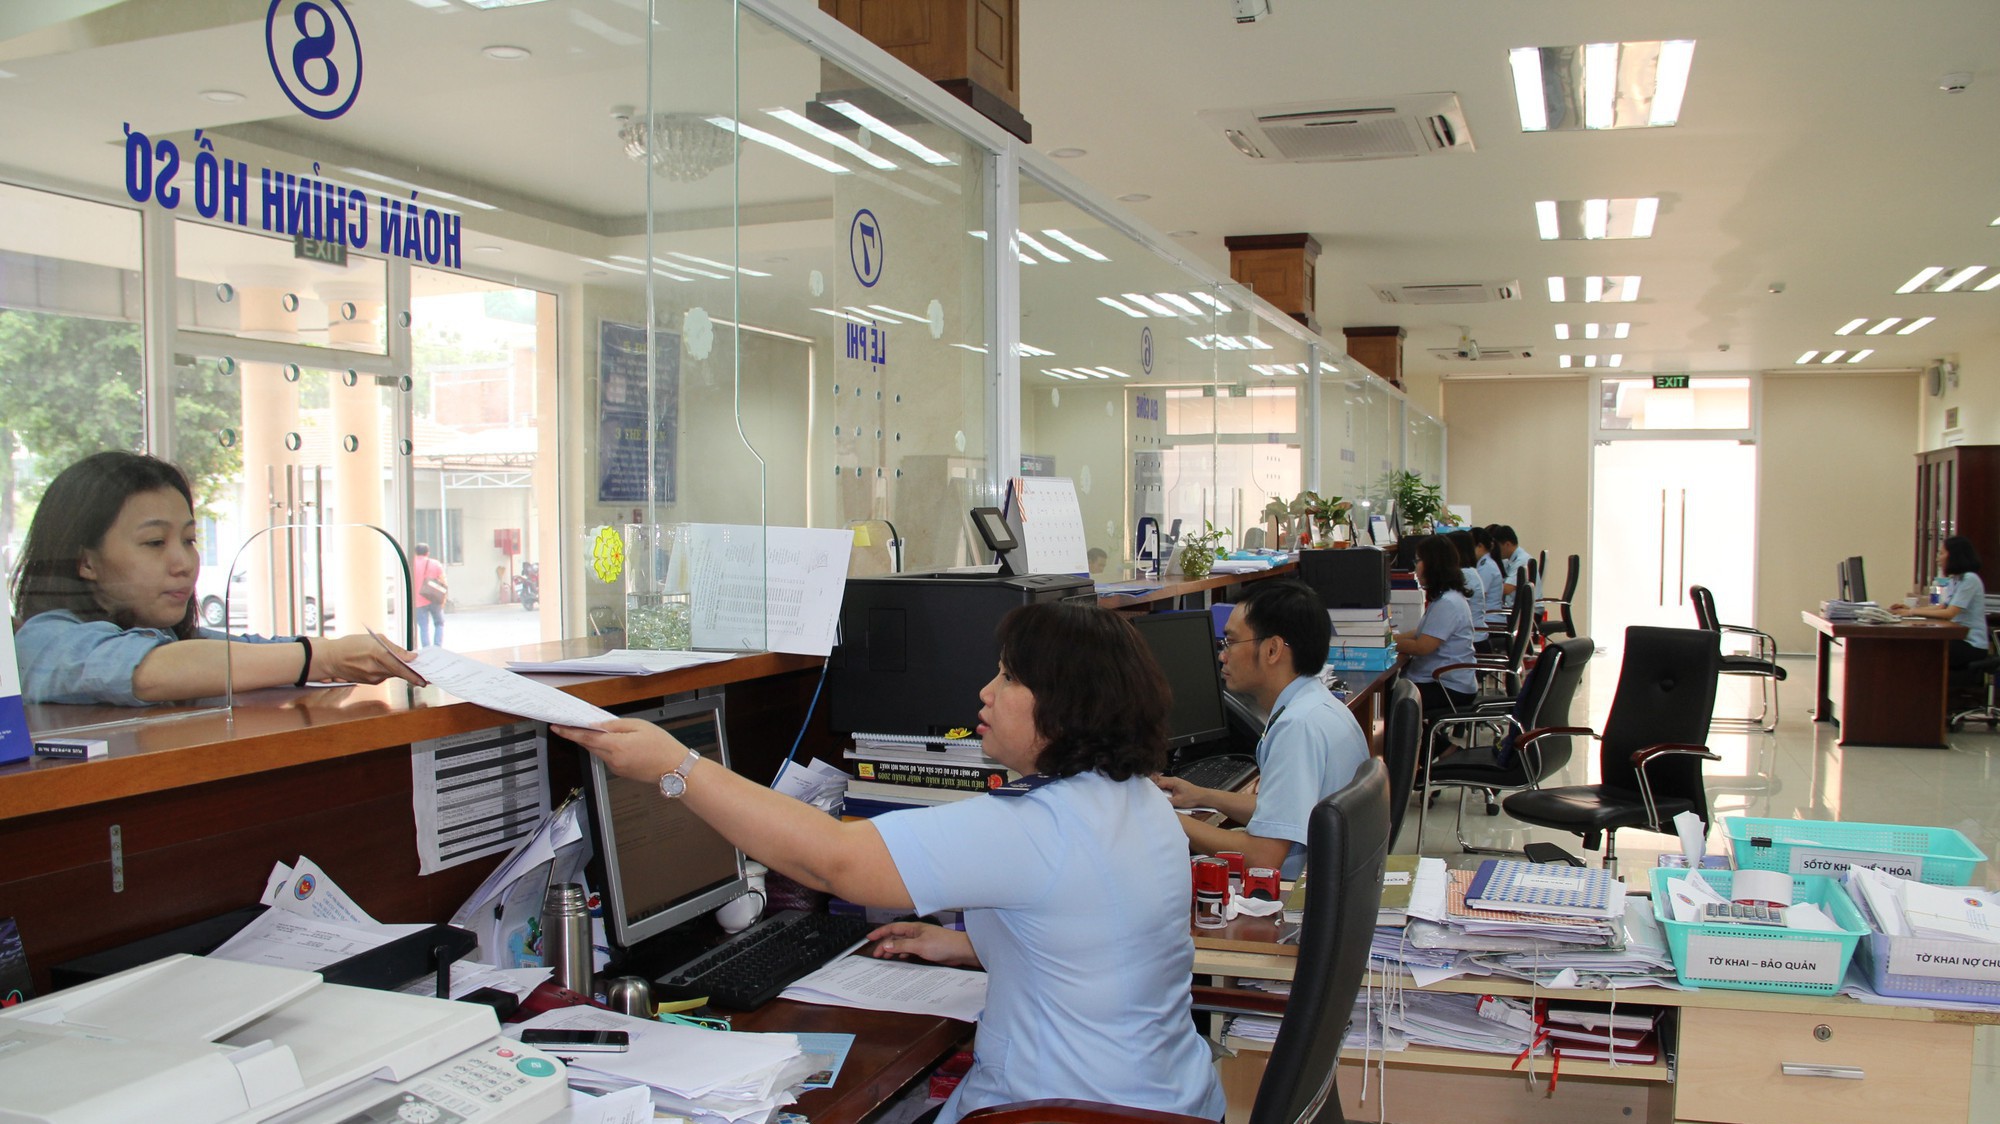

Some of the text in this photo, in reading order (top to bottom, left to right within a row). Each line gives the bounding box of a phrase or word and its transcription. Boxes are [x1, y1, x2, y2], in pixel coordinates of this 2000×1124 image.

[304, 239, 339, 263] EXIT
[1656, 376, 1686, 388] EXIT
[877, 772, 891, 780] 2009
[1889, 866, 1912, 876] HÓA
[1708, 956, 1724, 965] TỜ
[1725, 958, 1749, 967] KHAI
[1760, 958, 1783, 969] BẢO
[1785, 960, 1817, 970] QUẢN
[1915, 953, 1932, 963] TỜ
[1933, 955, 1960, 965] KHAI
[1962, 958, 1980, 967] NỢ
